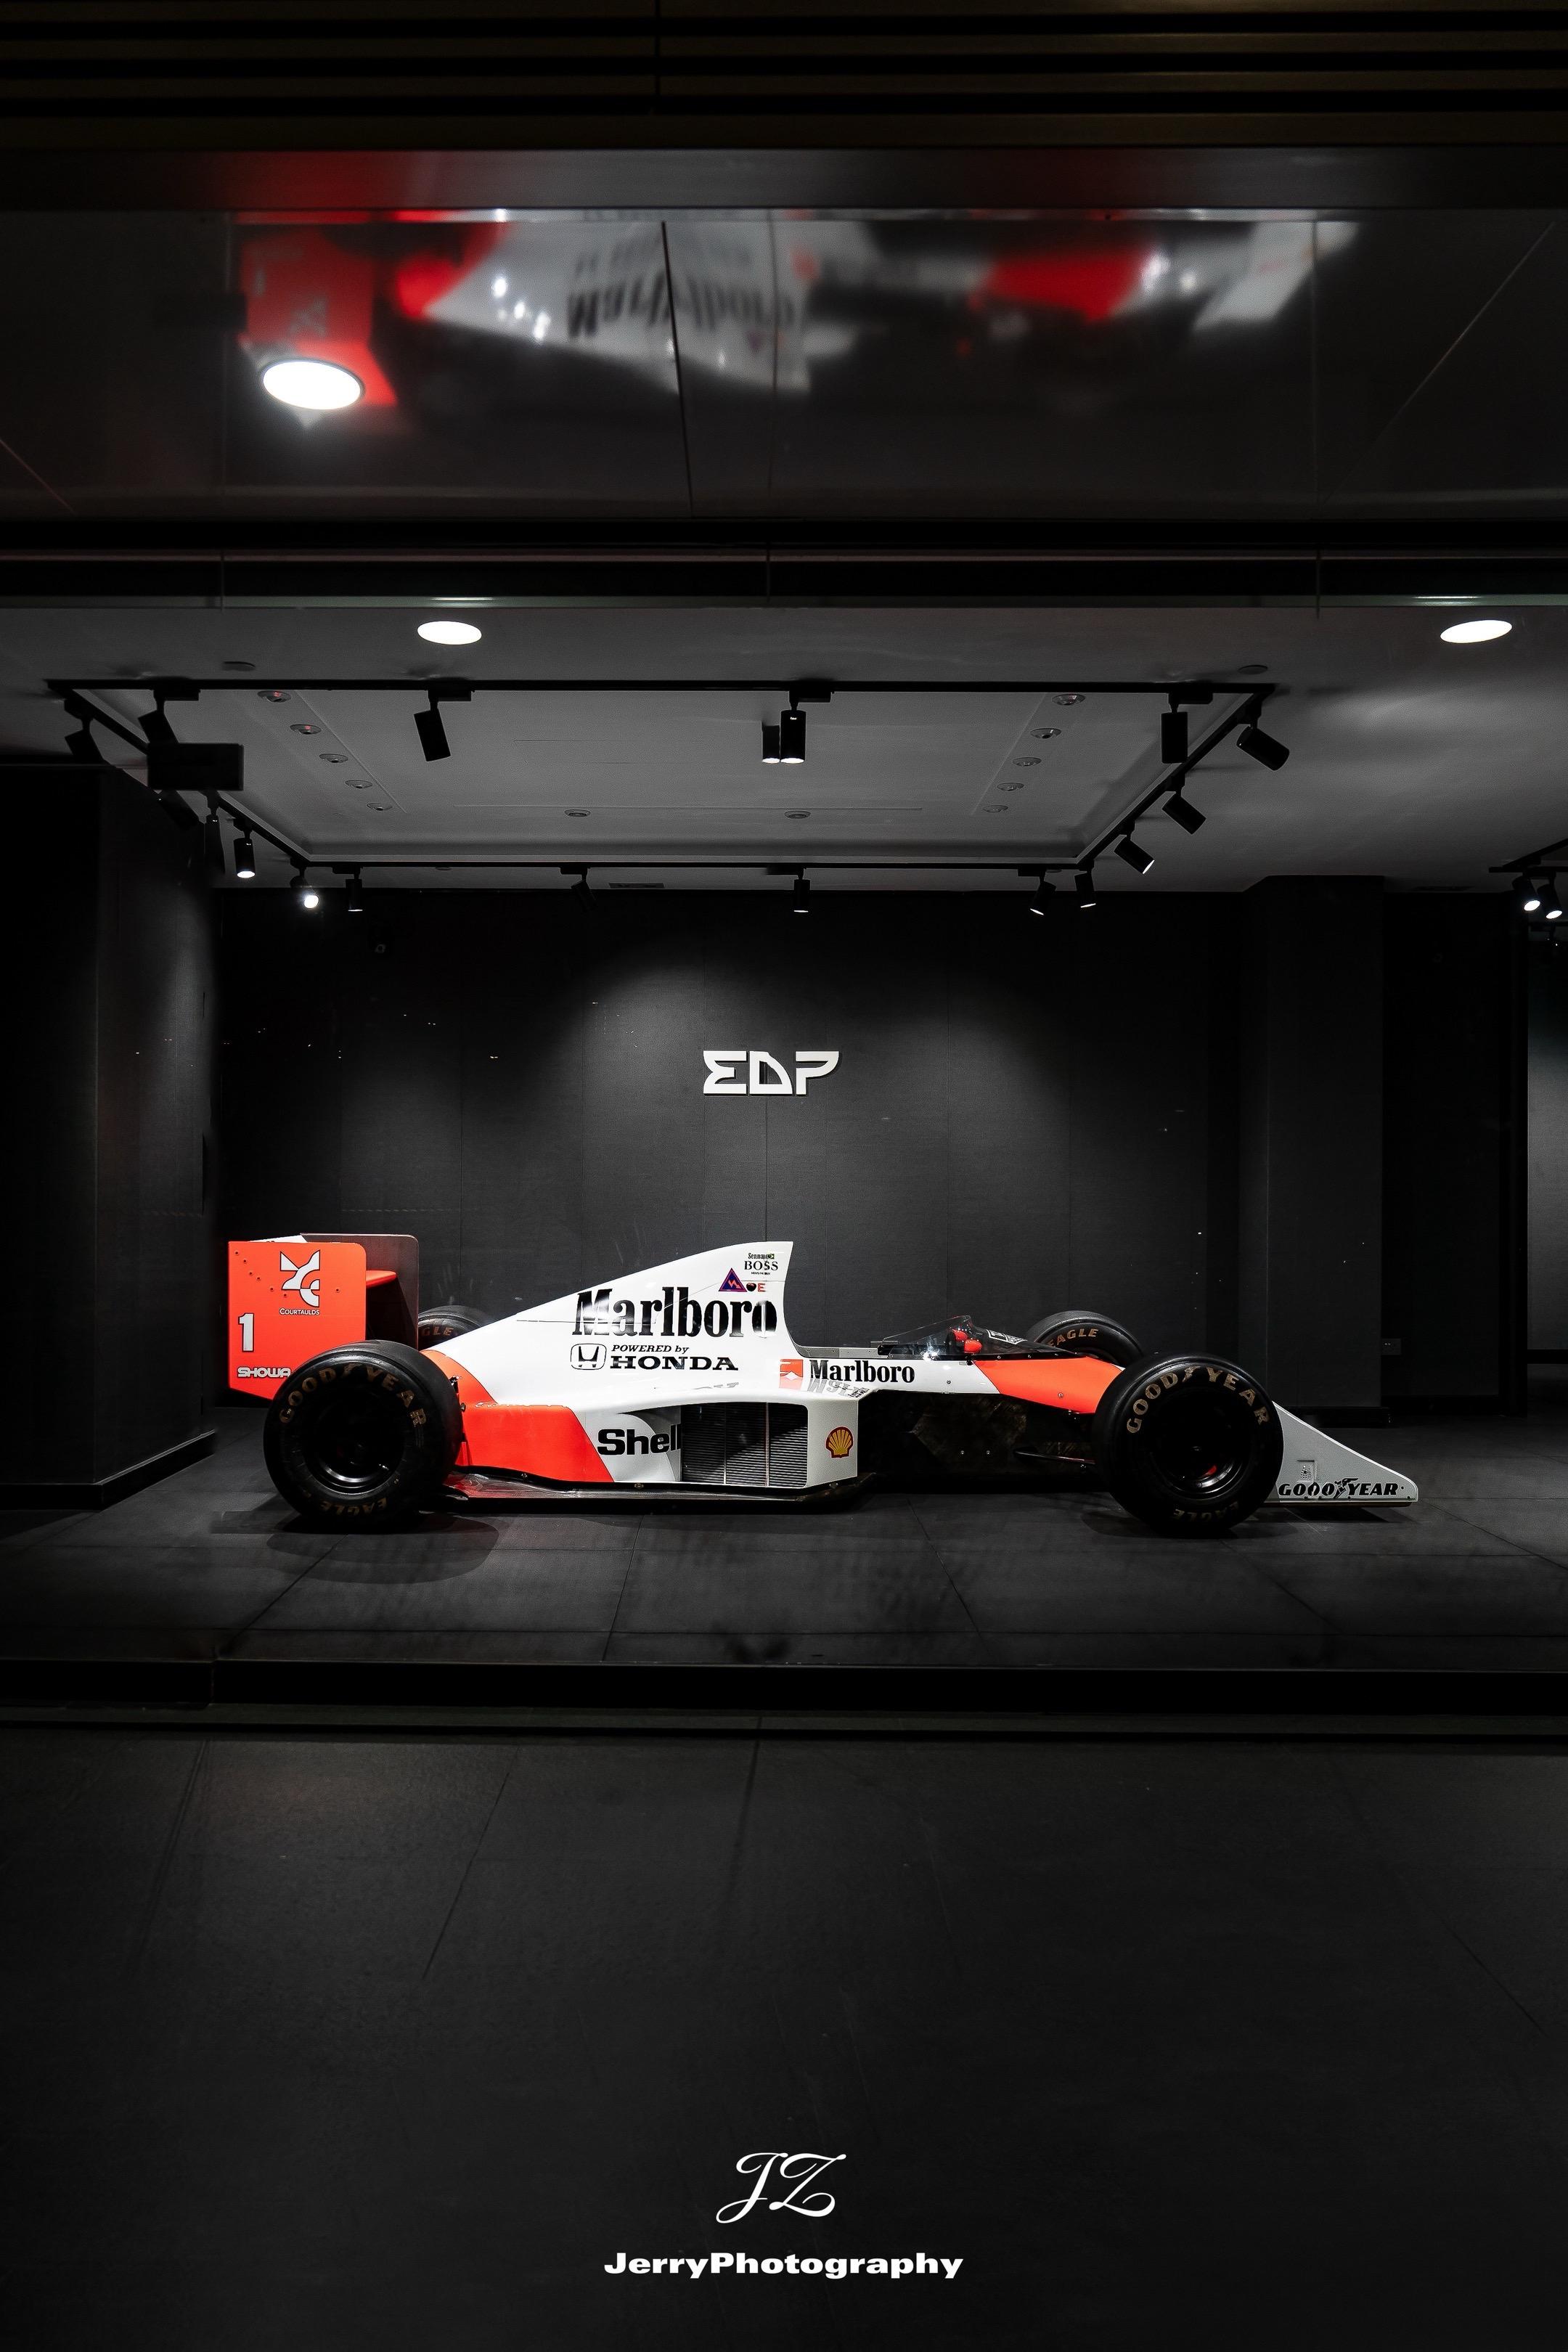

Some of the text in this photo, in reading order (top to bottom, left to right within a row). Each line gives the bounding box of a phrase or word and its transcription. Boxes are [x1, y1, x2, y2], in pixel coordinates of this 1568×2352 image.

[744, 1260, 778, 1270] BOSS
[572, 1286, 777, 1338] Marlboro
[238, 1312, 255, 1352] 1
[674, 1344, 690, 1355] by
[237, 1367, 291, 1379] SHOWA
[610, 1355, 739, 1371] HONDA
[809, 1359, 915, 1383] Marlboro
[597, 1424, 681, 1455] Shell
